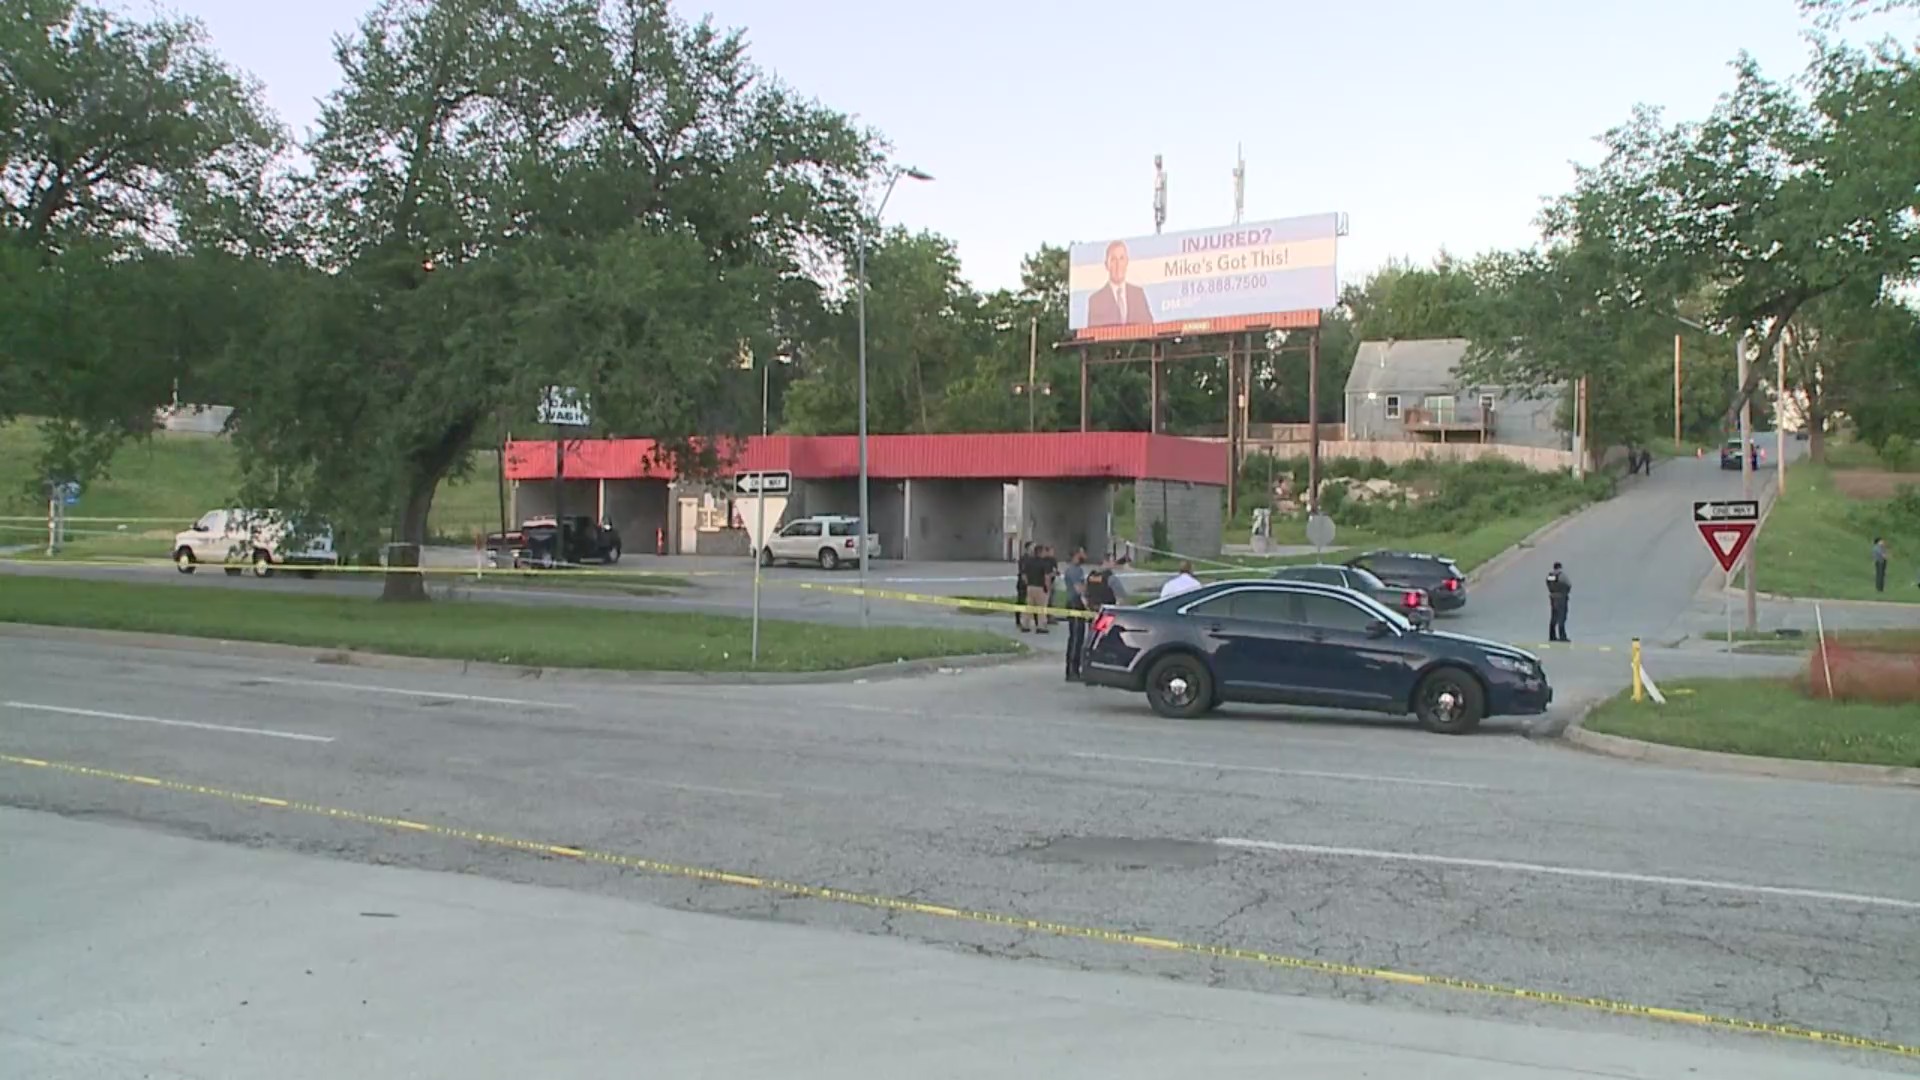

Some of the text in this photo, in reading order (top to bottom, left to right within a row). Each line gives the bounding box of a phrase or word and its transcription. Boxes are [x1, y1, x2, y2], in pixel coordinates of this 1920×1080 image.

[1181, 227, 1273, 253] INJURED?
[1164, 247, 1289, 278] Mike's Got This!
[1181, 274, 1267, 297] 816.888.7500
[1732, 505, 1752, 515] WAY
